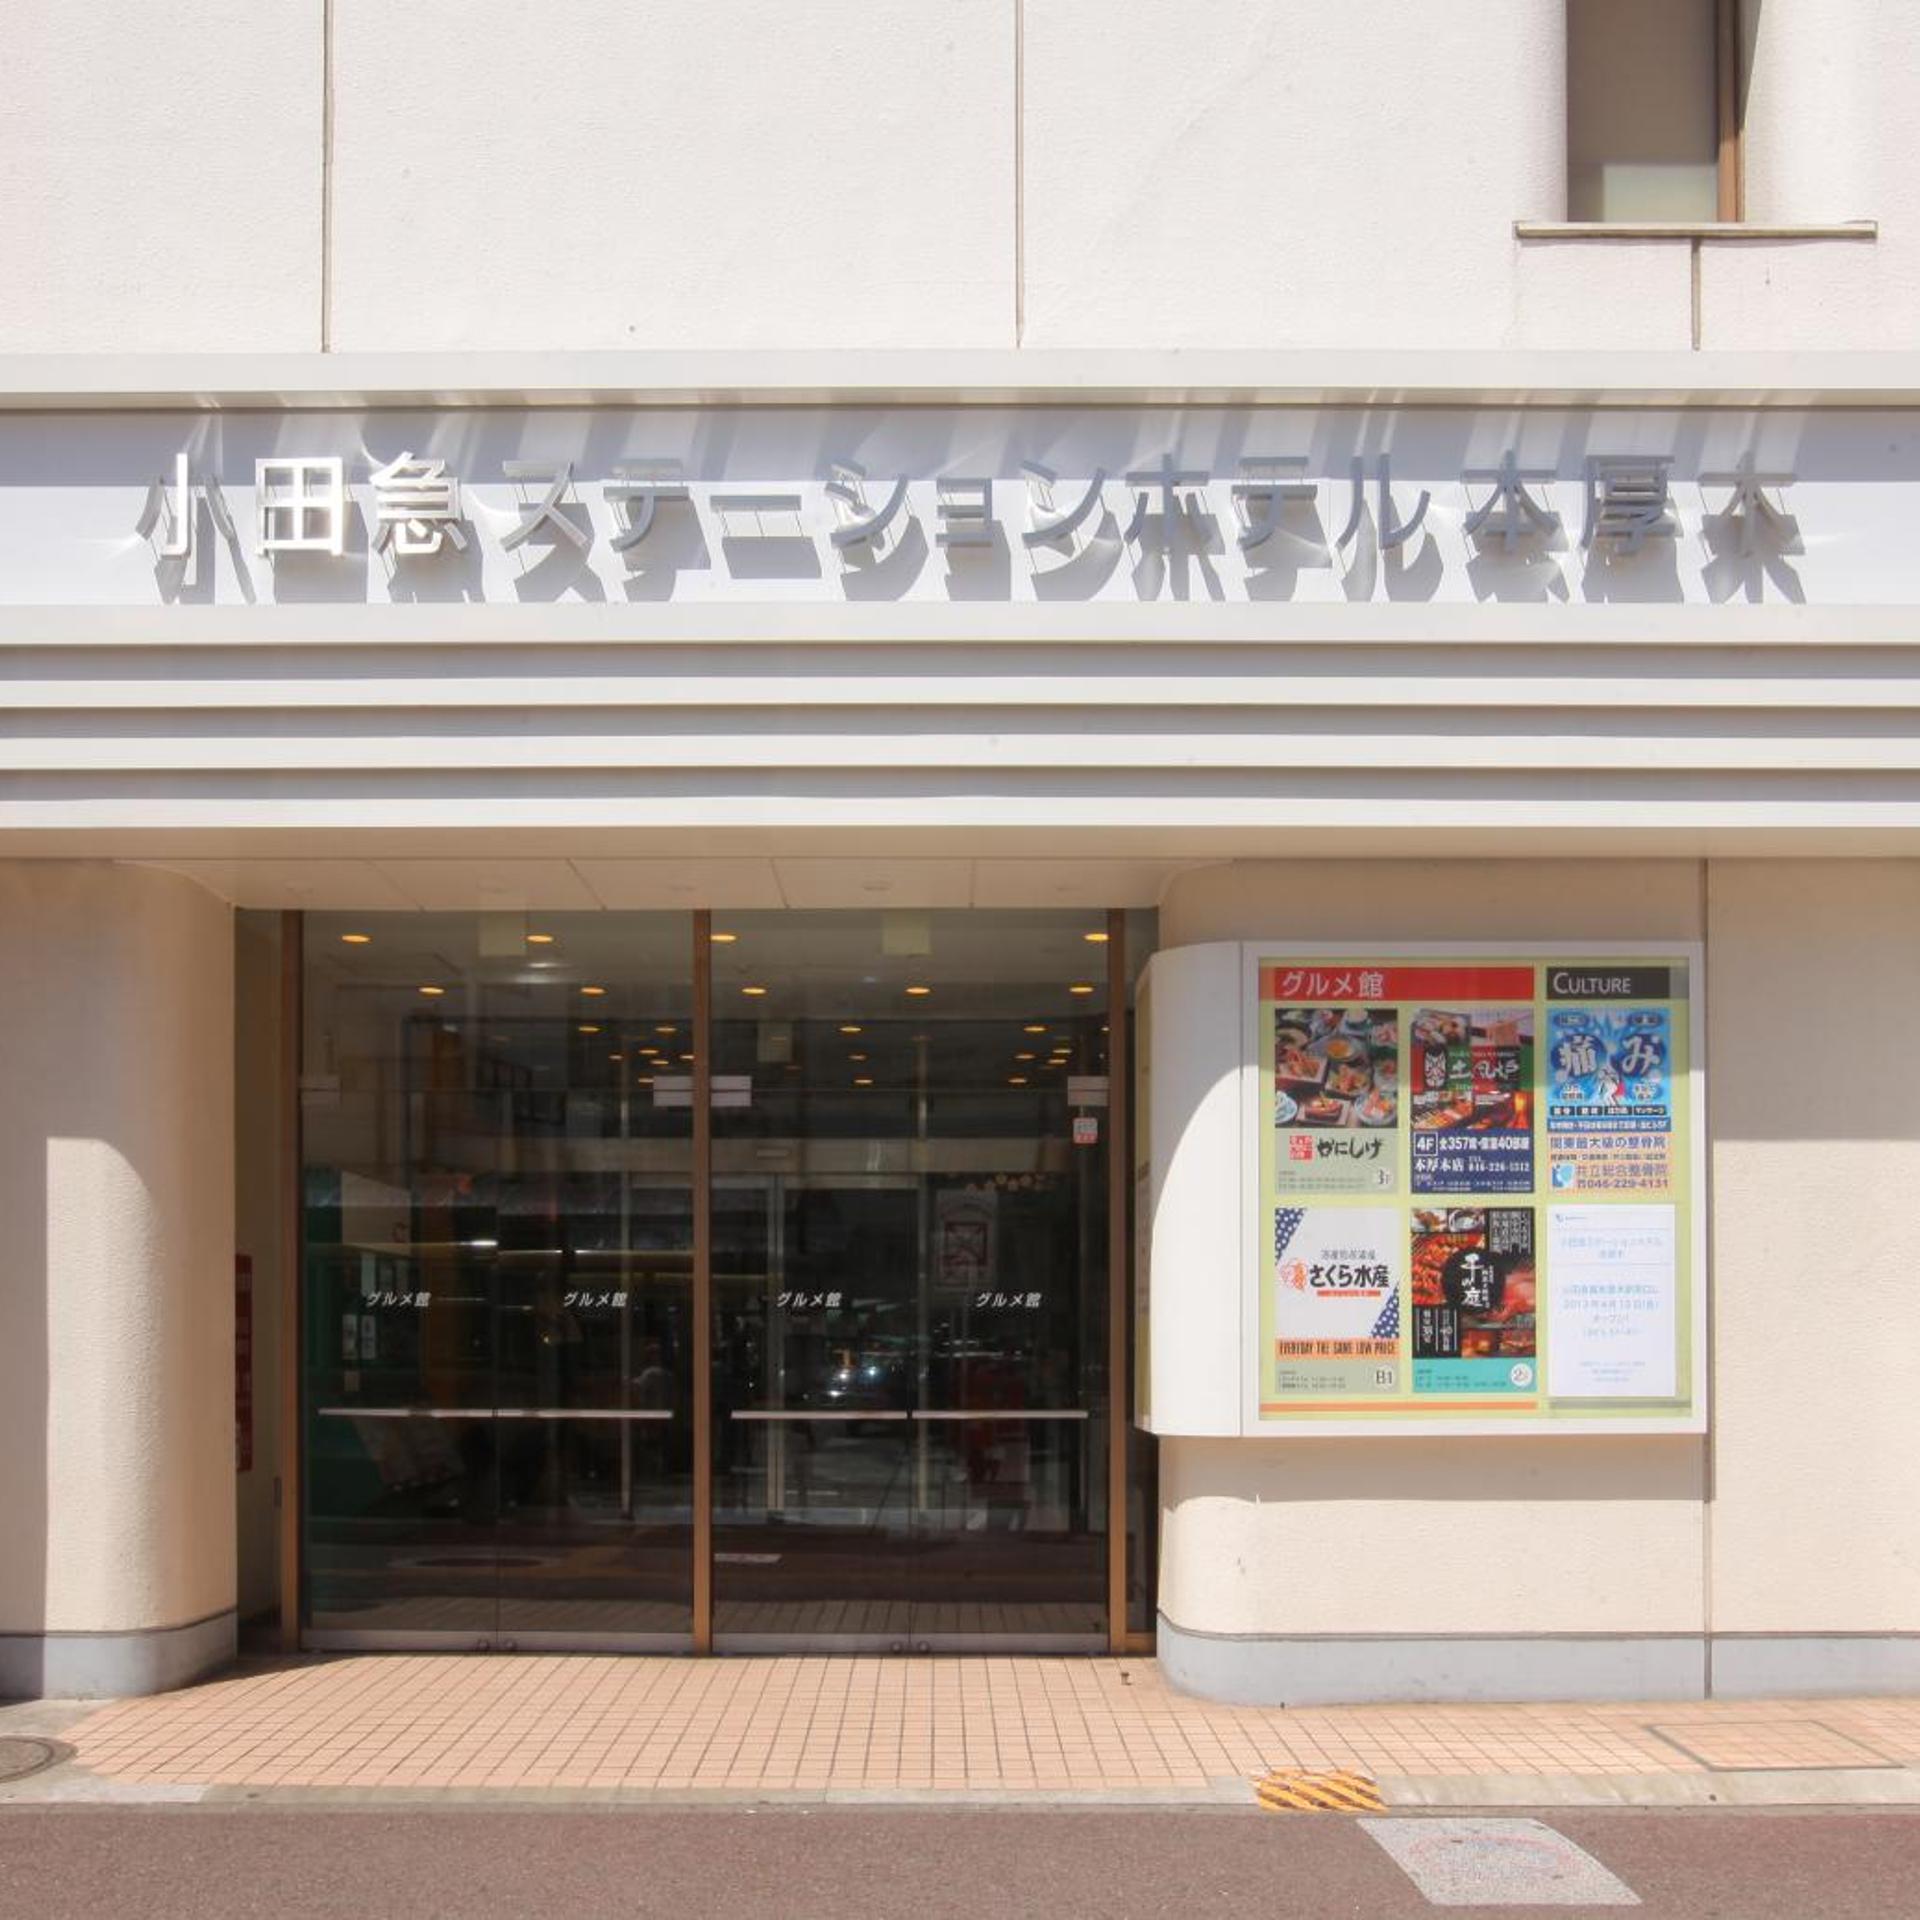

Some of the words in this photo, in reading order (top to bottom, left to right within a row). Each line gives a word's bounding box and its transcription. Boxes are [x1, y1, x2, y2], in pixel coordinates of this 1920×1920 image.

[135, 451, 1796, 557] 小田急ステーションホテル本厚木
[1282, 971, 1384, 998] グルメ館
[1417, 1137, 1434, 1151] 4F
[1310, 1264, 1389, 1288] さくら水産
[367, 1292, 431, 1307] グルメ館
[563, 1292, 628, 1307] グルメ館
[777, 1292, 843, 1307] グルメ館
[976, 1292, 1042, 1307] グルメ館
[1376, 1370, 1392, 1384] B1
